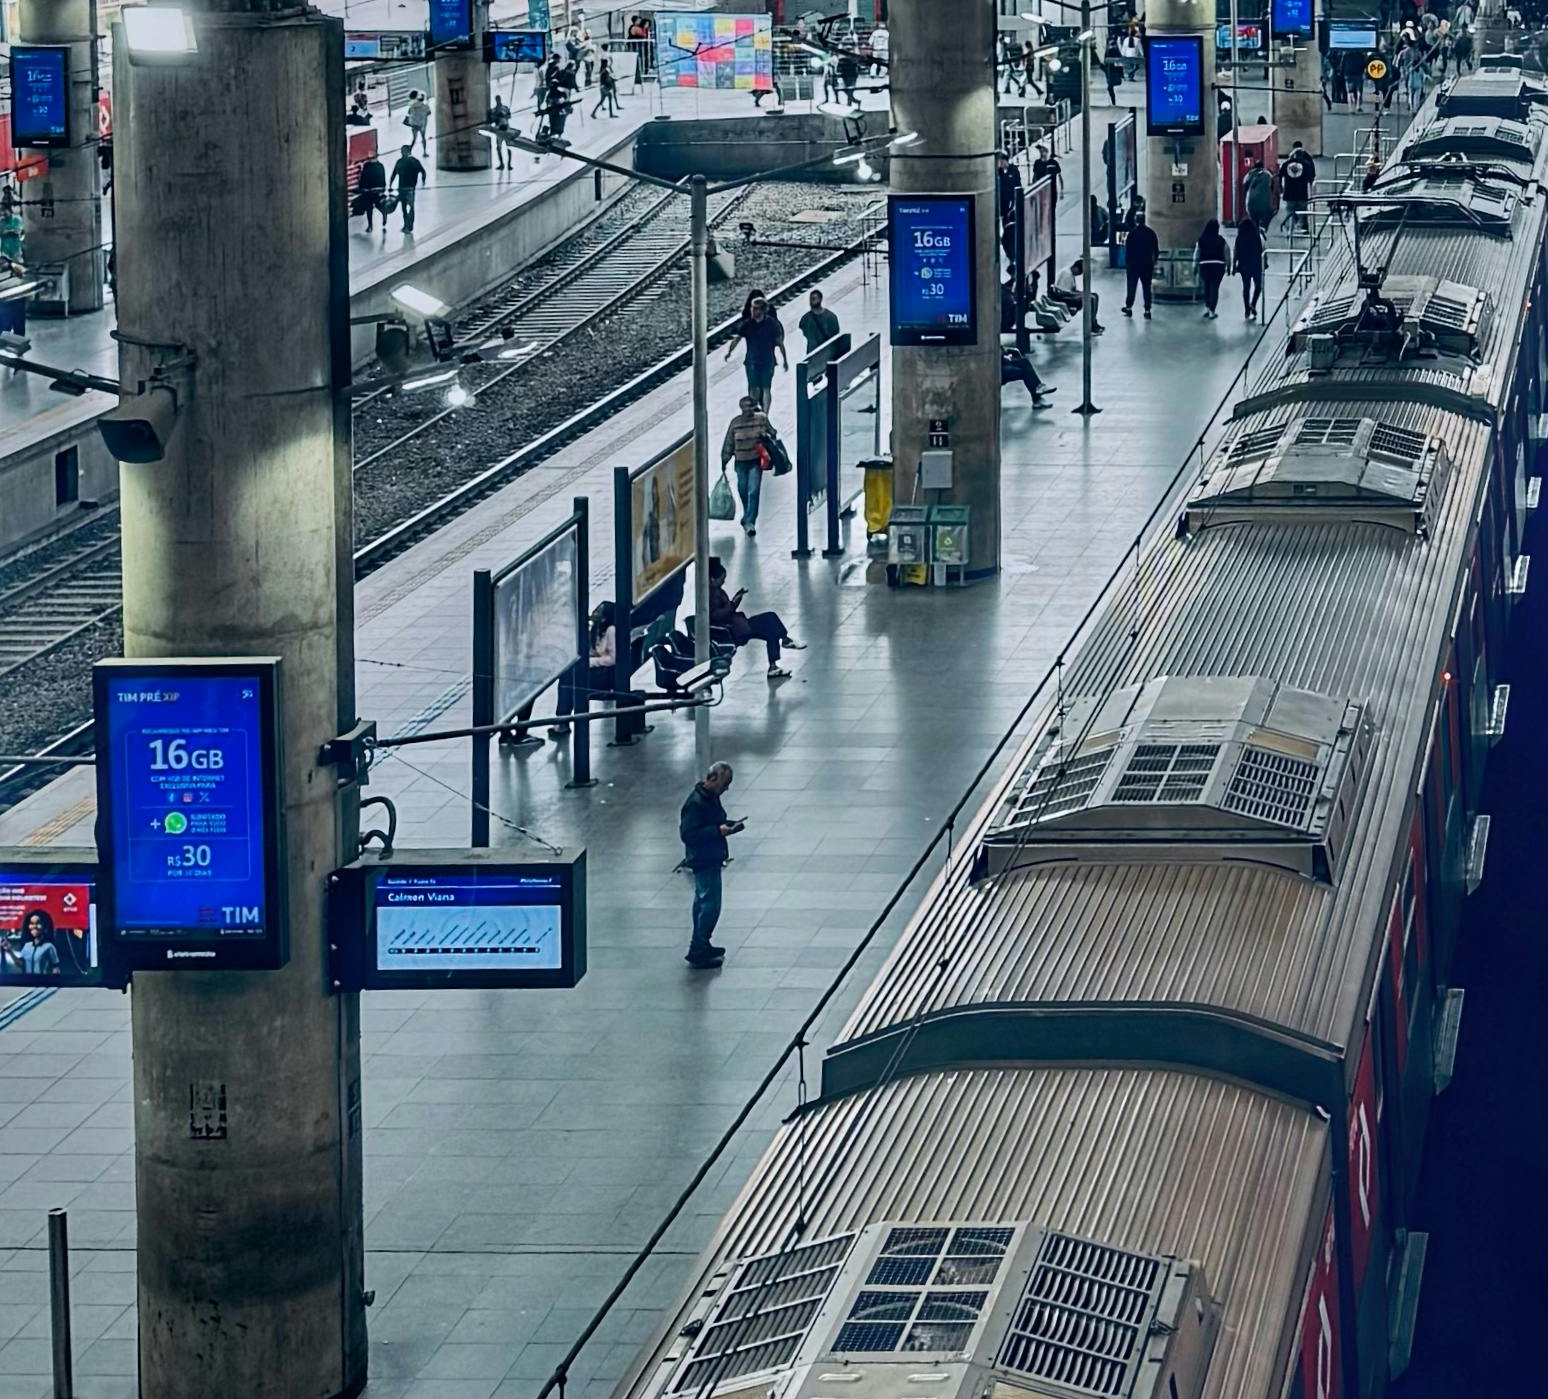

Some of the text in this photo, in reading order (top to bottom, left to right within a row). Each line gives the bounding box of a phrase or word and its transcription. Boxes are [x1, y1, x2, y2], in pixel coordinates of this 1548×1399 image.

[139, 689, 162, 703] PRÉ
[149, 738, 225, 771] 16GB
[427, 892, 455, 901] Viana
[221, 906, 260, 924] TIM
